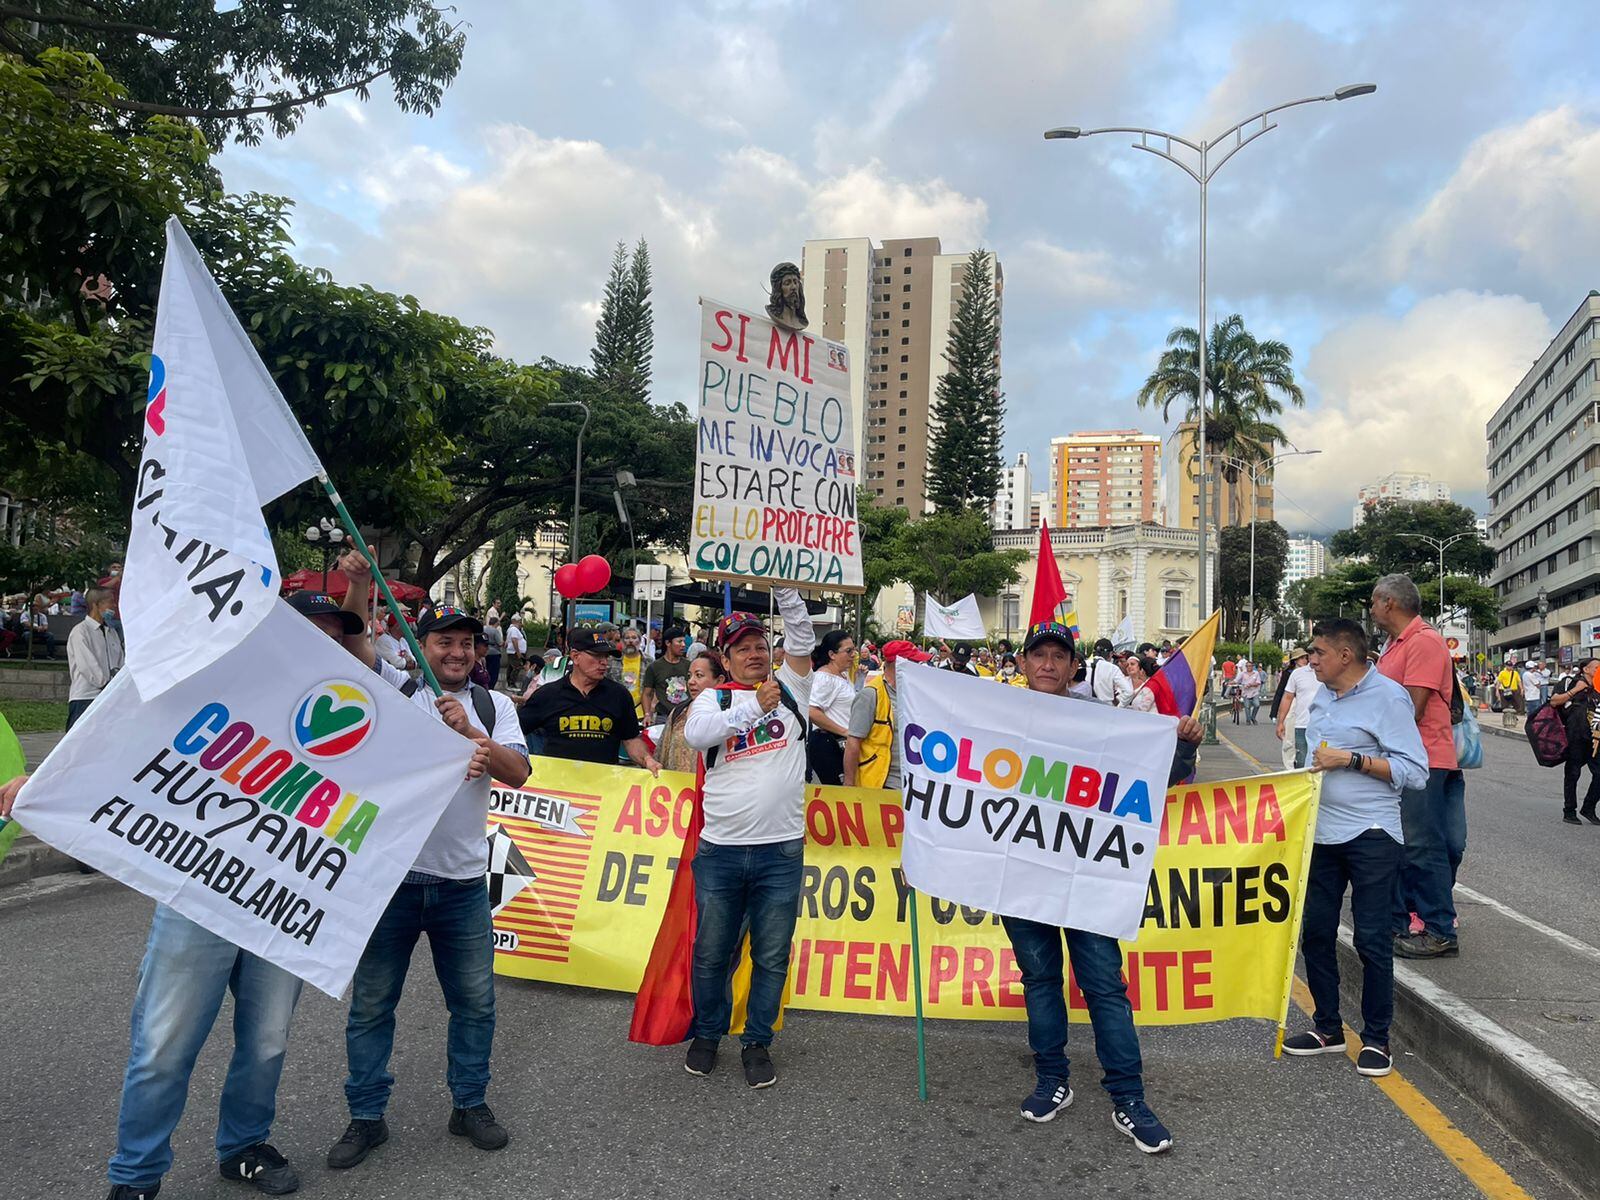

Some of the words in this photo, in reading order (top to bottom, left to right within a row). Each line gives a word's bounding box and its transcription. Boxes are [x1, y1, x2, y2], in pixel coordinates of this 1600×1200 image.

[711, 310, 750, 363] SI
[767, 326, 815, 384] MI
[702, 361, 842, 443] PUEBLO
[699, 416, 736, 457] ME
[749, 423, 838, 478] INVOCA
[700, 461, 805, 509] ESTARE
[814, 477, 856, 518] CON
[695, 541, 843, 585] COLOMBIA
[733, 506, 759, 541] LO
[762, 506, 856, 556] PROTEJERE
[172, 702, 380, 856] COLOMBIA
[904, 723, 1153, 823] COLOMBIA
[132, 747, 348, 892] HUMANA
[89, 795, 326, 947] FLORIDABLANCA
[596, 851, 654, 906] DE
[791, 939, 911, 1002] ITEN
